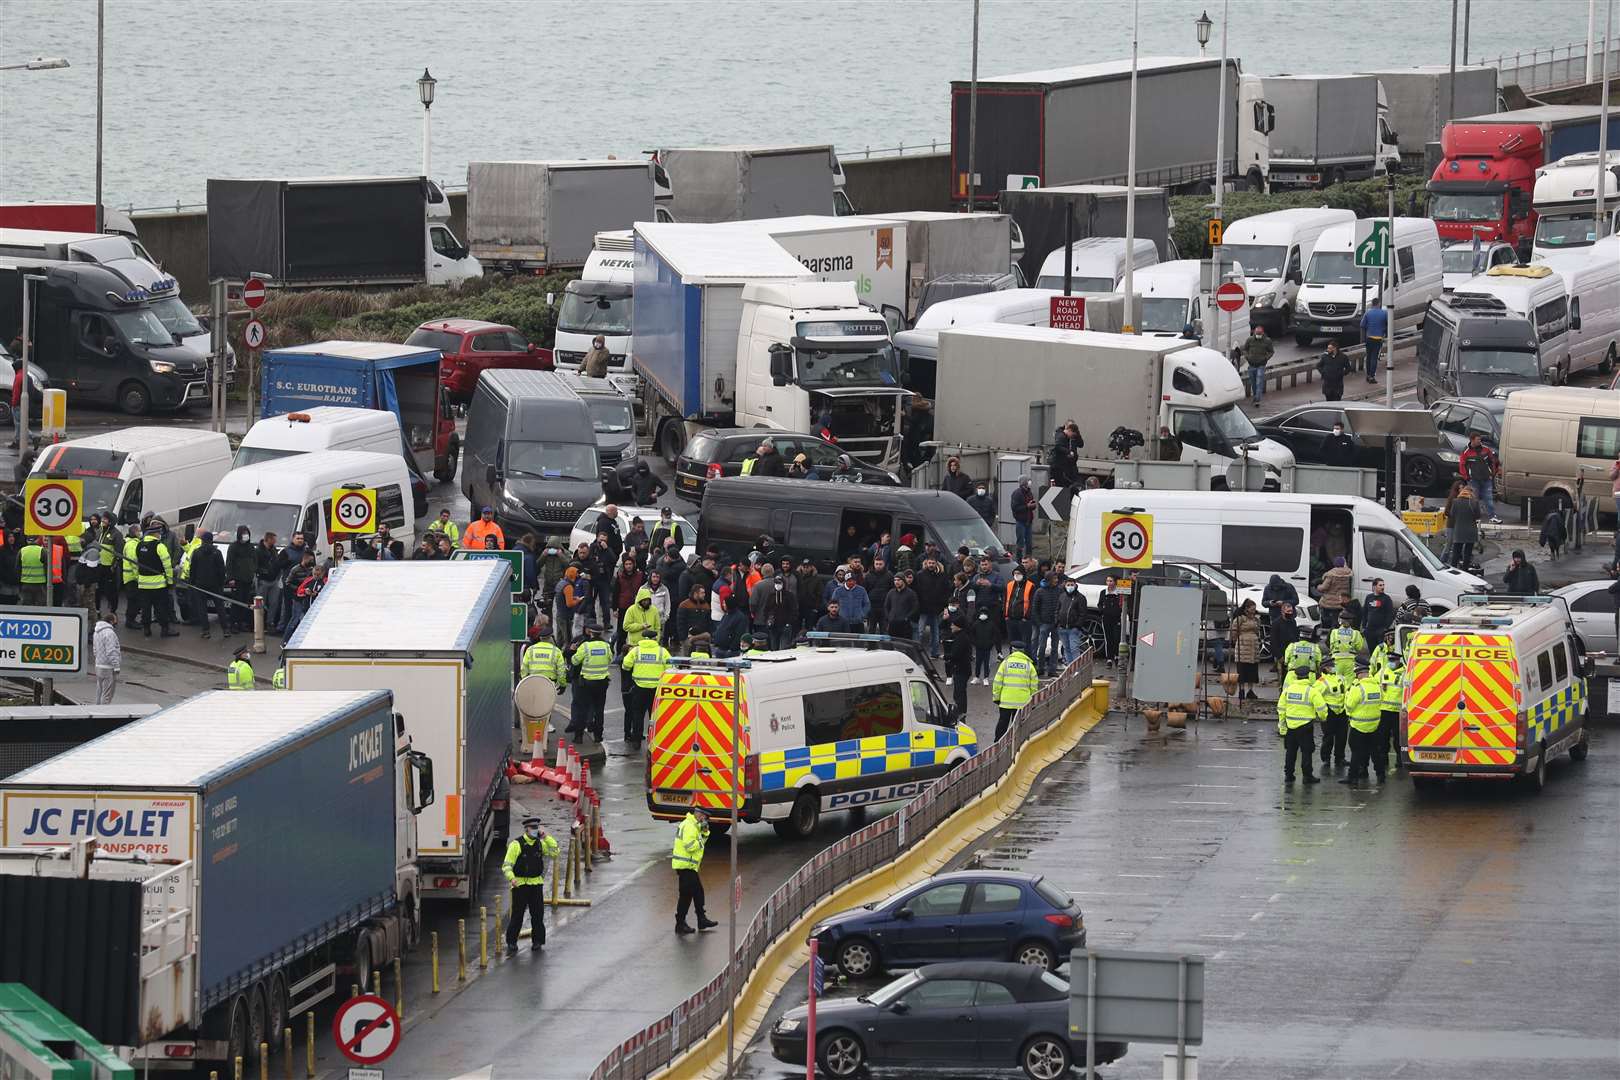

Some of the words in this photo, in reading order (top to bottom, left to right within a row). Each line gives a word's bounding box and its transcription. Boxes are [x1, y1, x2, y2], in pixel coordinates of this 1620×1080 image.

[1052, 314, 1083, 322] LAYOUT
[1056, 307, 1079, 315] ROAD
[276, 381, 294, 390] S.C.
[297, 383, 358, 395] EUROTRANS
[37, 498, 71, 517] 30
[341, 503, 367, 518] 30
[1112, 531, 1143, 550] 30
[0, 621, 49, 638] (M20)
[23, 646, 72, 663] (A20)
[1416, 648, 1509, 660] POLICE
[348, 734, 358, 772] JC
[23, 808, 62, 836] JC
[70, 809, 175, 837] FIOLET
